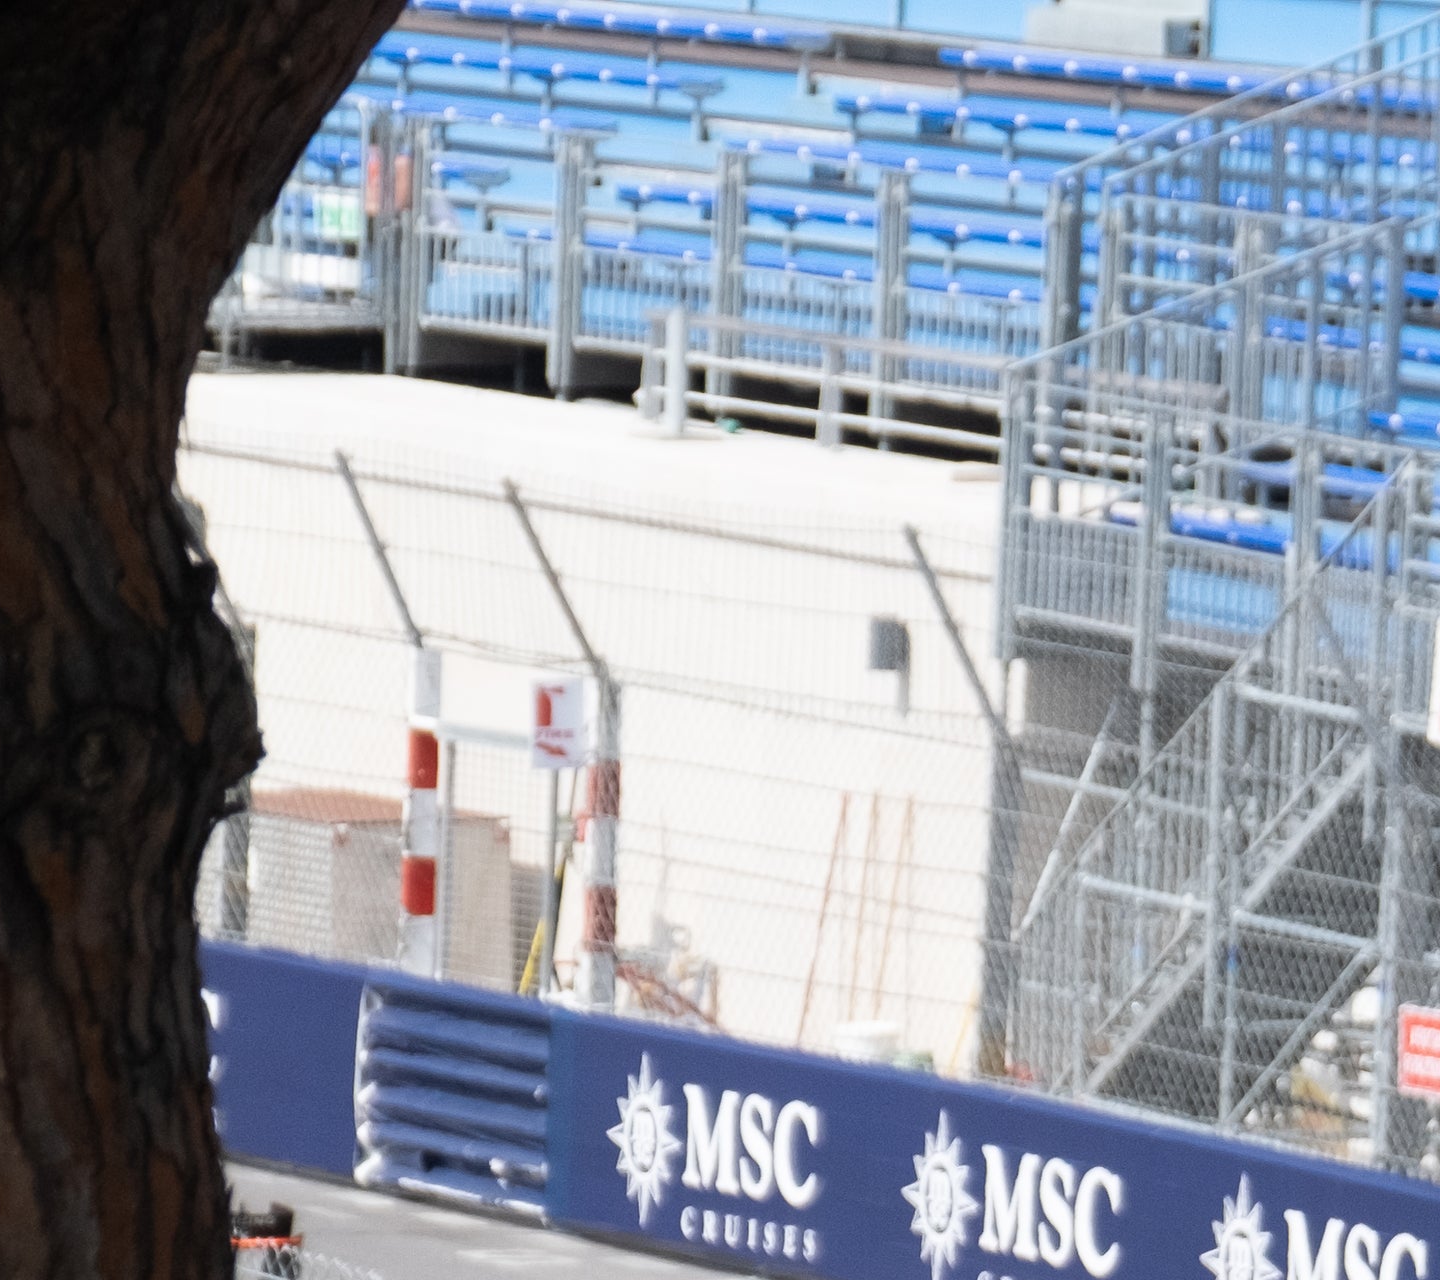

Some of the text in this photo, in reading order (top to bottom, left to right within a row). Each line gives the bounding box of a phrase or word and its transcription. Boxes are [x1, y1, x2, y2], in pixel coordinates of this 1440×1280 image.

[681, 1083, 820, 1209] MSC
[680, 1205, 819, 1263] CRUISES
[979, 1144, 1122, 1279] MSC
